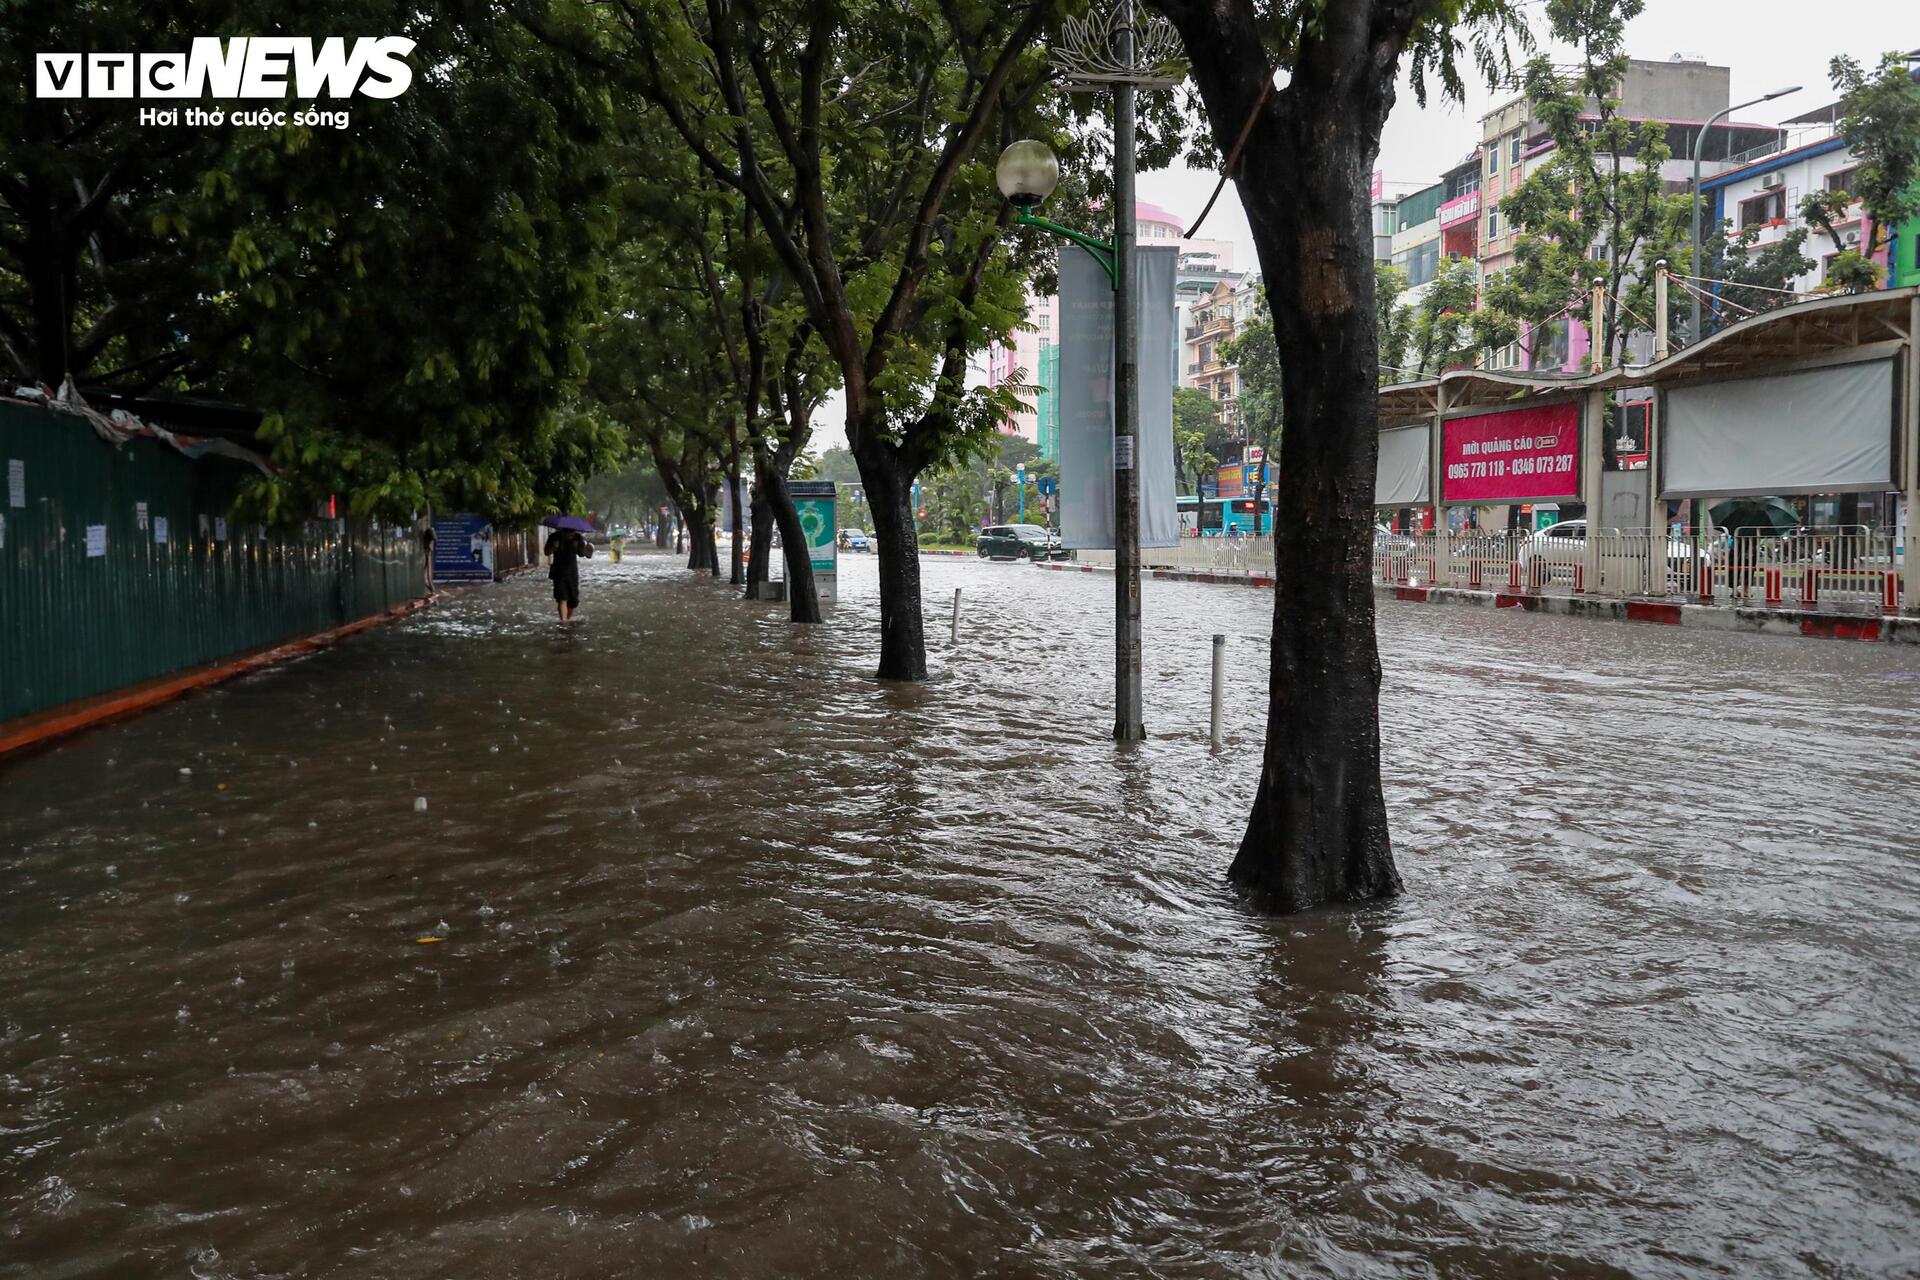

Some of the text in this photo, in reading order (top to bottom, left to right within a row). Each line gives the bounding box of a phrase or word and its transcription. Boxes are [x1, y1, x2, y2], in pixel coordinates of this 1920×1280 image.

[1462, 440, 1480, 455] MỜI
[1481, 436, 1512, 454] QUẢNG
[1513, 435, 1532, 450] CÁO
[1448, 463, 1469, 479] 0965
[1471, 461, 1487, 478] 778
[1488, 460, 1505, 476] 118
[1512, 457, 1534, 475] 0346
[1536, 455, 1554, 473] 073
[1555, 454, 1574, 472] 287
